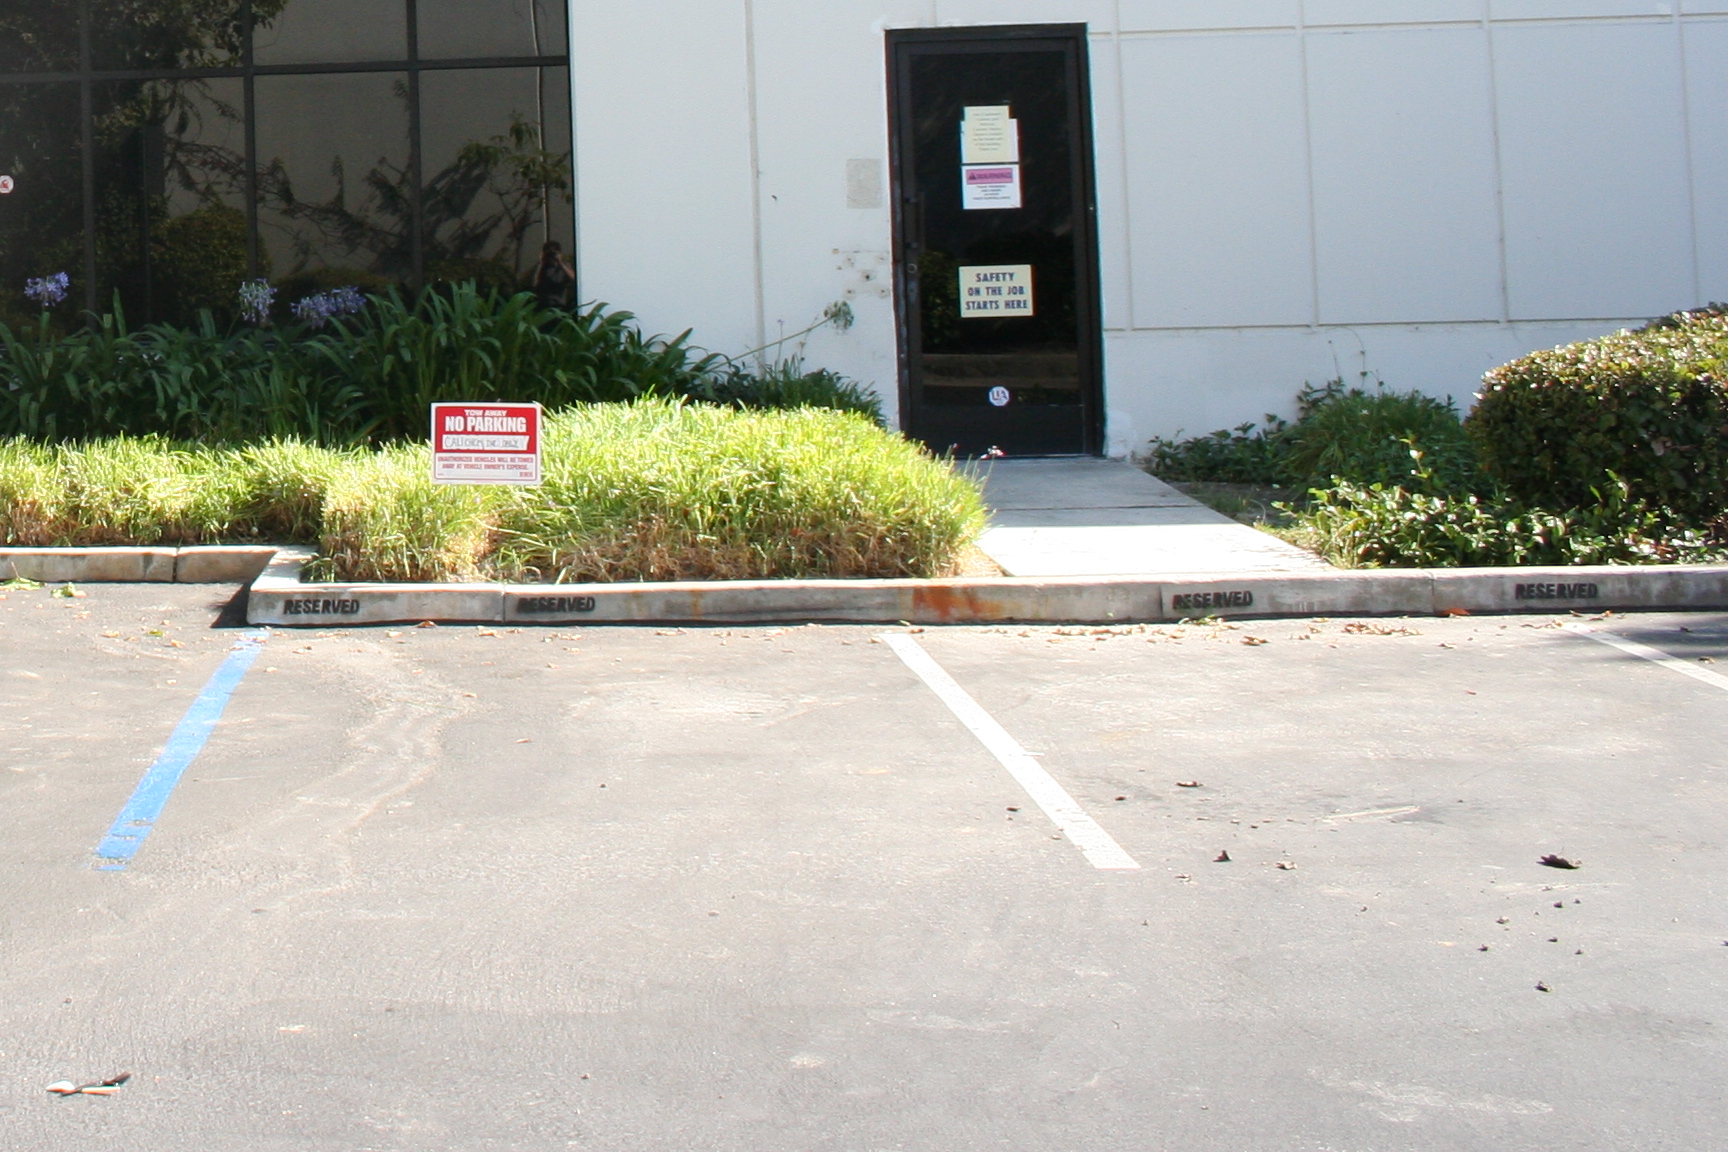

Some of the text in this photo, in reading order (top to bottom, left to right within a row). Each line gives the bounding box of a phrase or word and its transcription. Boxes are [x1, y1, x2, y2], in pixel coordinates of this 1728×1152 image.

[975, 272, 1014, 282] SAFETY
[967, 285, 1024, 296] ON THE JOB
[965, 299, 1027, 310] STARTS HERE
[445, 416, 527, 432] NO PARKING
[1515, 583, 1598, 599] RESERVED
[283, 599, 360, 615] RESERVED
[517, 596, 596, 613] RESERVED
[1173, 590, 1253, 609] RESERVED
